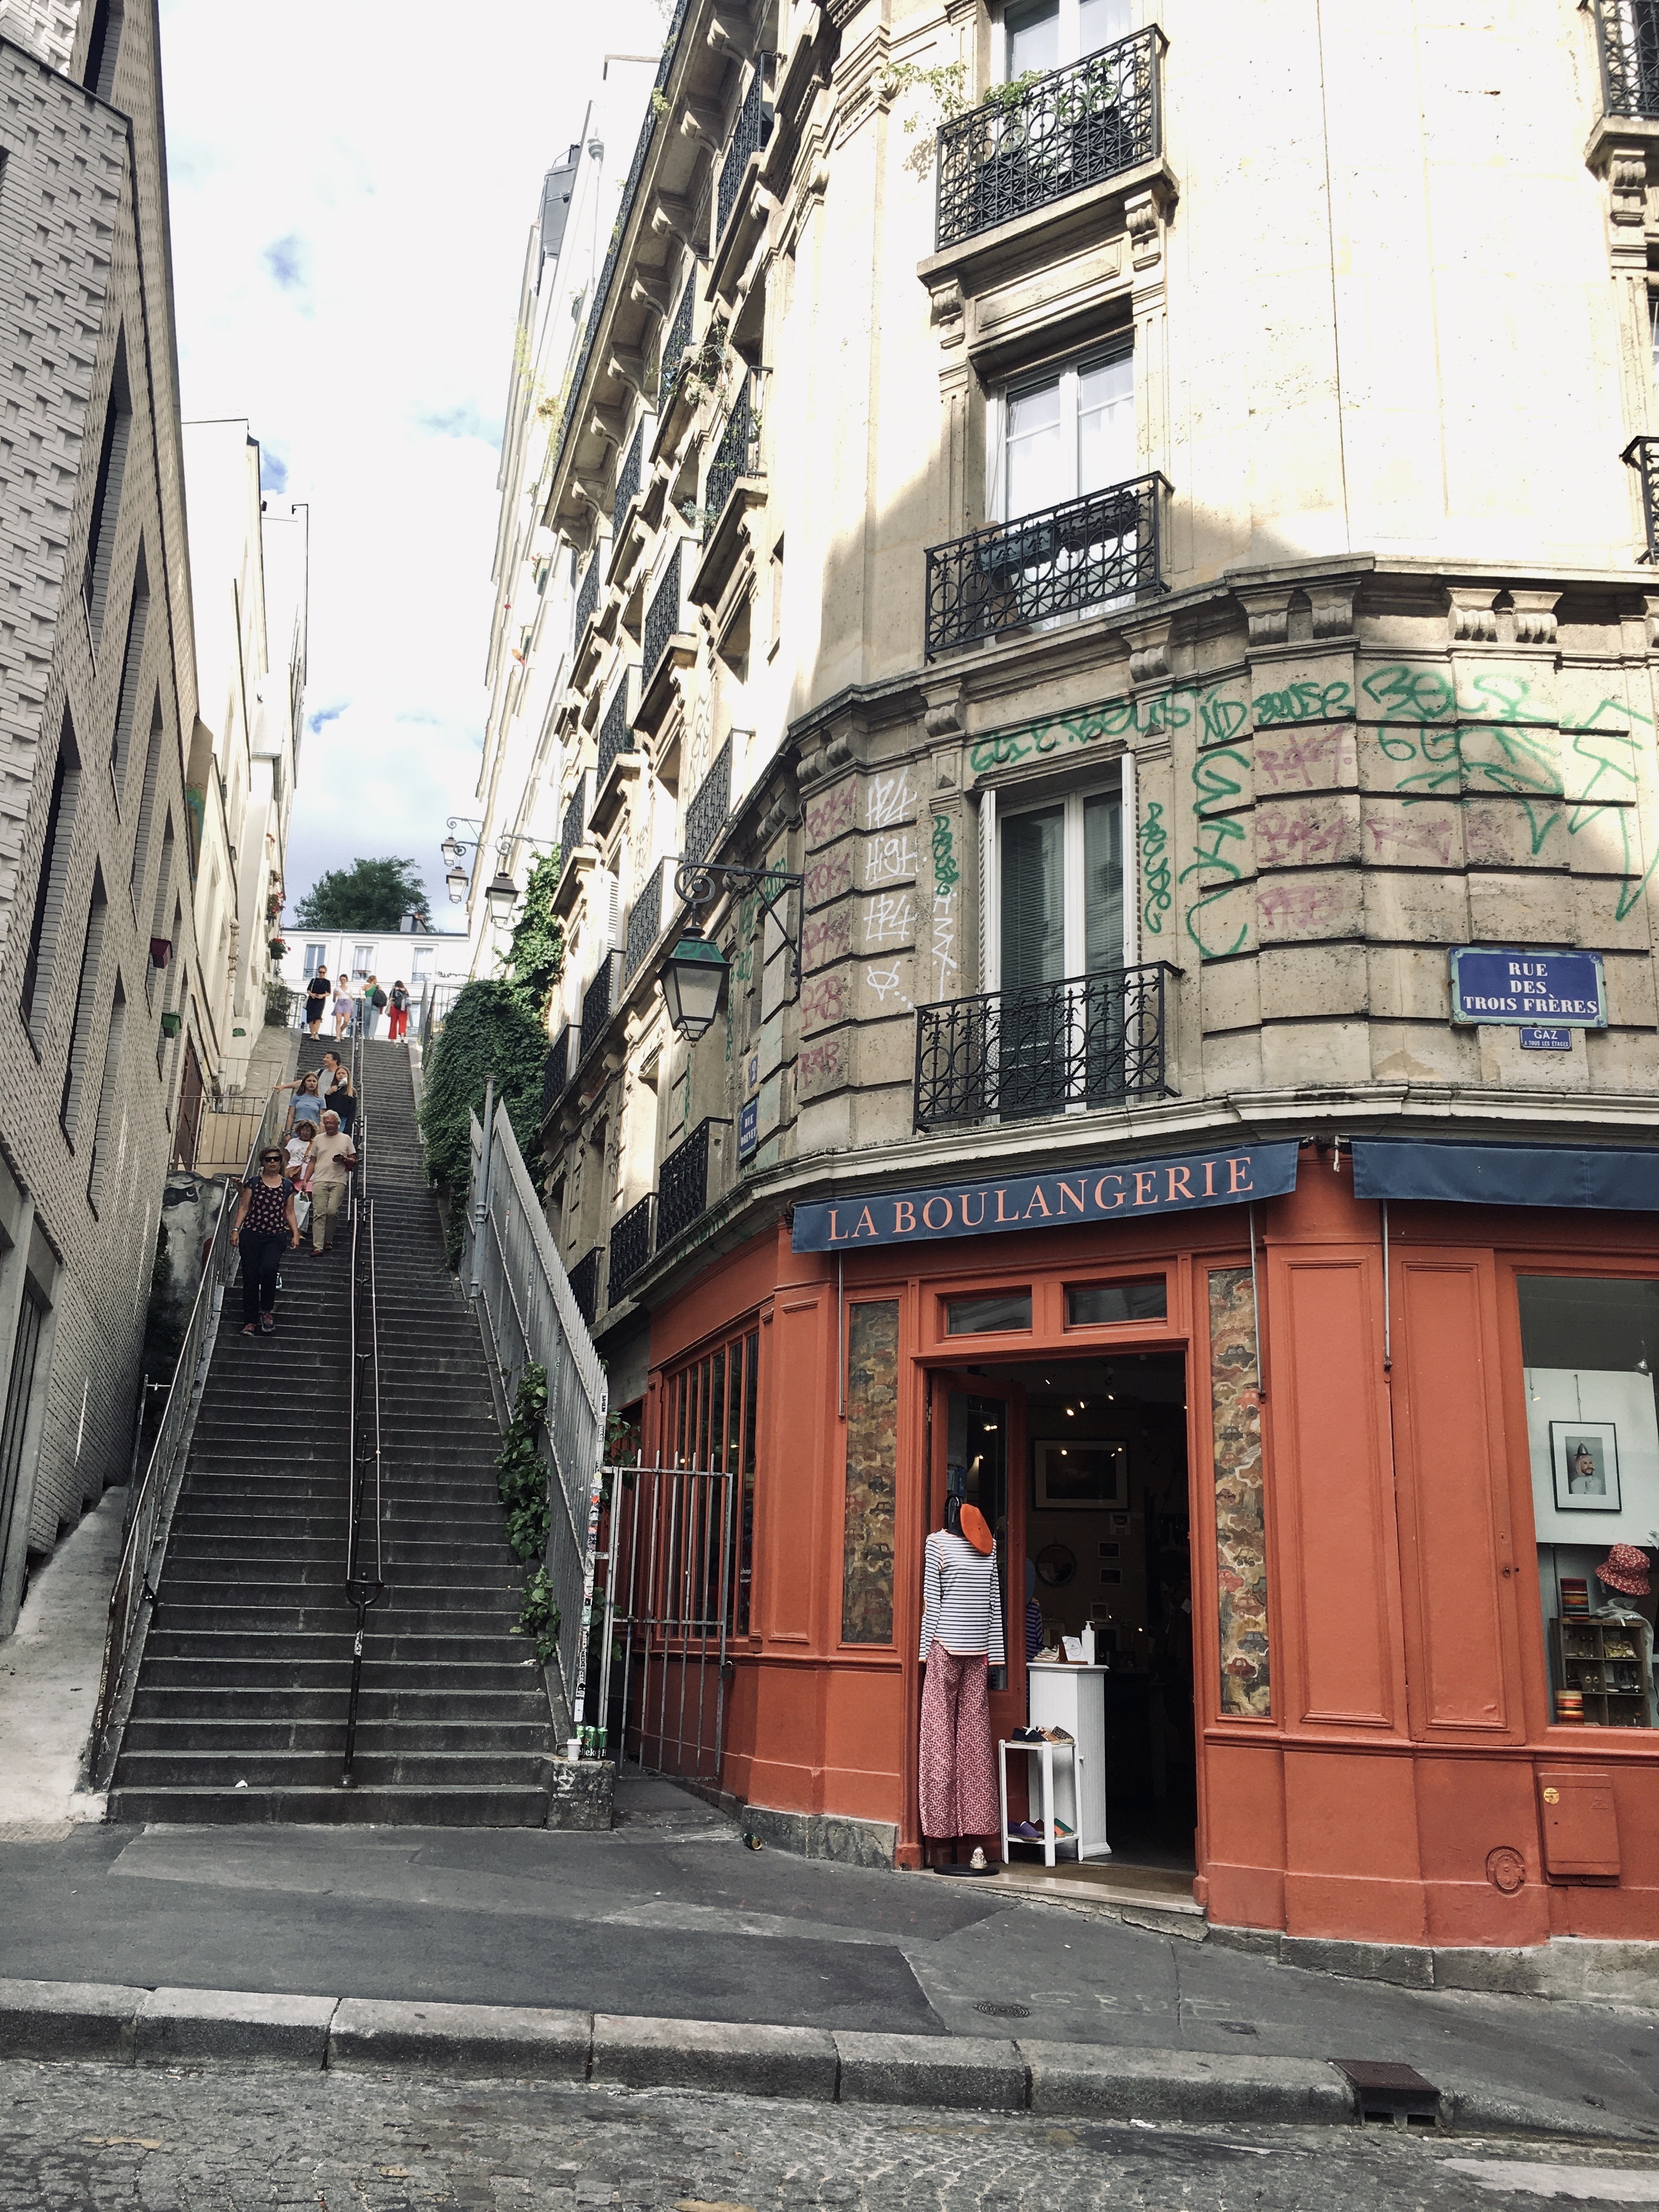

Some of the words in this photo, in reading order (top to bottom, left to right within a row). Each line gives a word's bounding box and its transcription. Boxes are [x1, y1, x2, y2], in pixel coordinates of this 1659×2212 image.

[1509, 962, 1548, 977] RUE
[1510, 980, 1547, 994] DES
[1463, 996, 1517, 1011] TROIS
[1523, 994, 1598, 1014] FRÈRES
[1533, 1030, 1558, 1040] GAZ
[744, 1113, 754, 1128] RUE
[827, 1205, 879, 1242] LA
[891, 1156, 1255, 1234] BOULANGERIE
